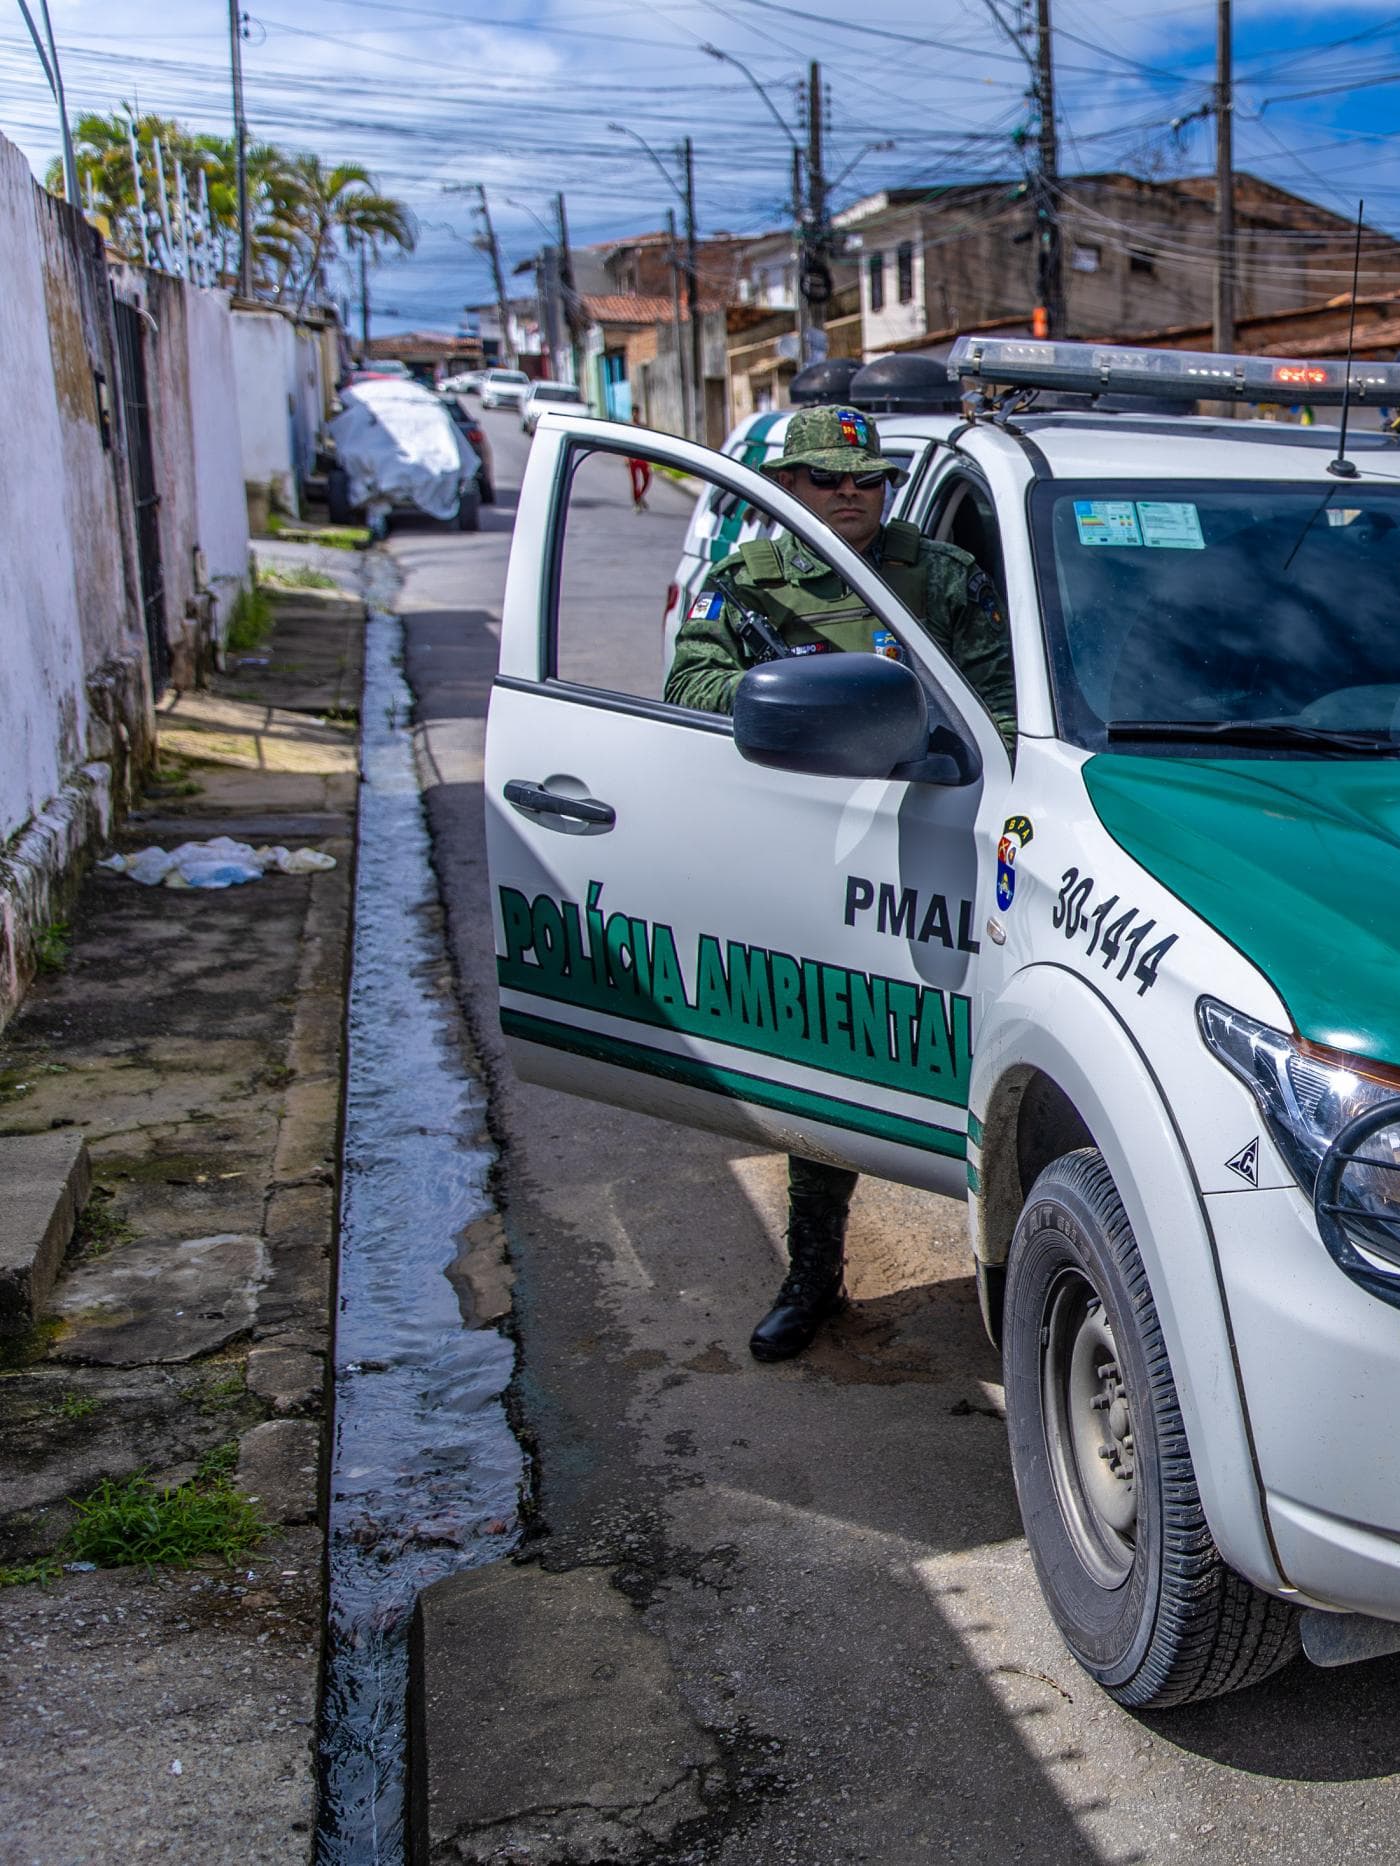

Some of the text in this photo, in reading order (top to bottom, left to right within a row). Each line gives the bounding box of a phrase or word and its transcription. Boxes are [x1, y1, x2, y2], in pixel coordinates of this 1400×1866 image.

[498, 880, 692, 1011] POLÍCIA
[844, 876, 981, 954] PMAL
[1053, 867, 1180, 997] 30-1414
